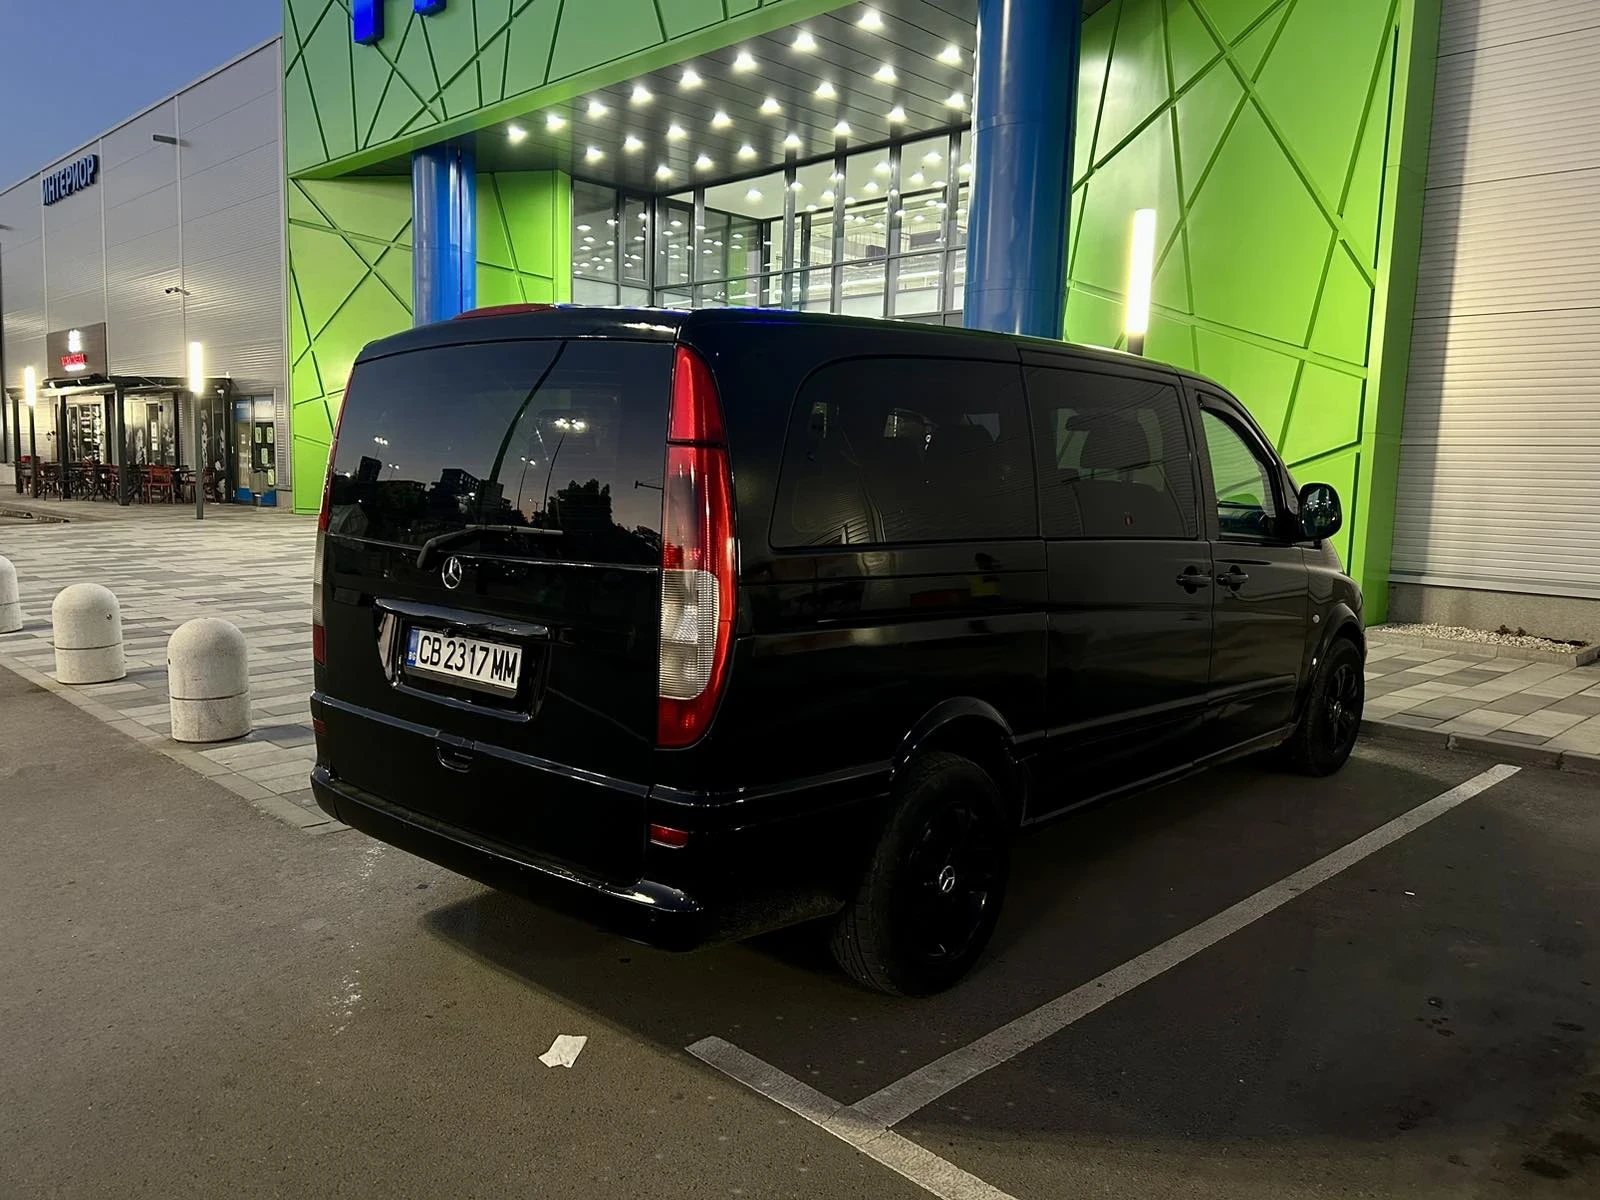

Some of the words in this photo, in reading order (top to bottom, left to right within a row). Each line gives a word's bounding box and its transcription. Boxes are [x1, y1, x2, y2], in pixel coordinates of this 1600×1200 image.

[42, 154, 98, 206] ИНТЕРИОР
[419, 635, 442, 666] CB
[443, 640, 490, 676] 2317
[490, 648, 518, 683] MM
